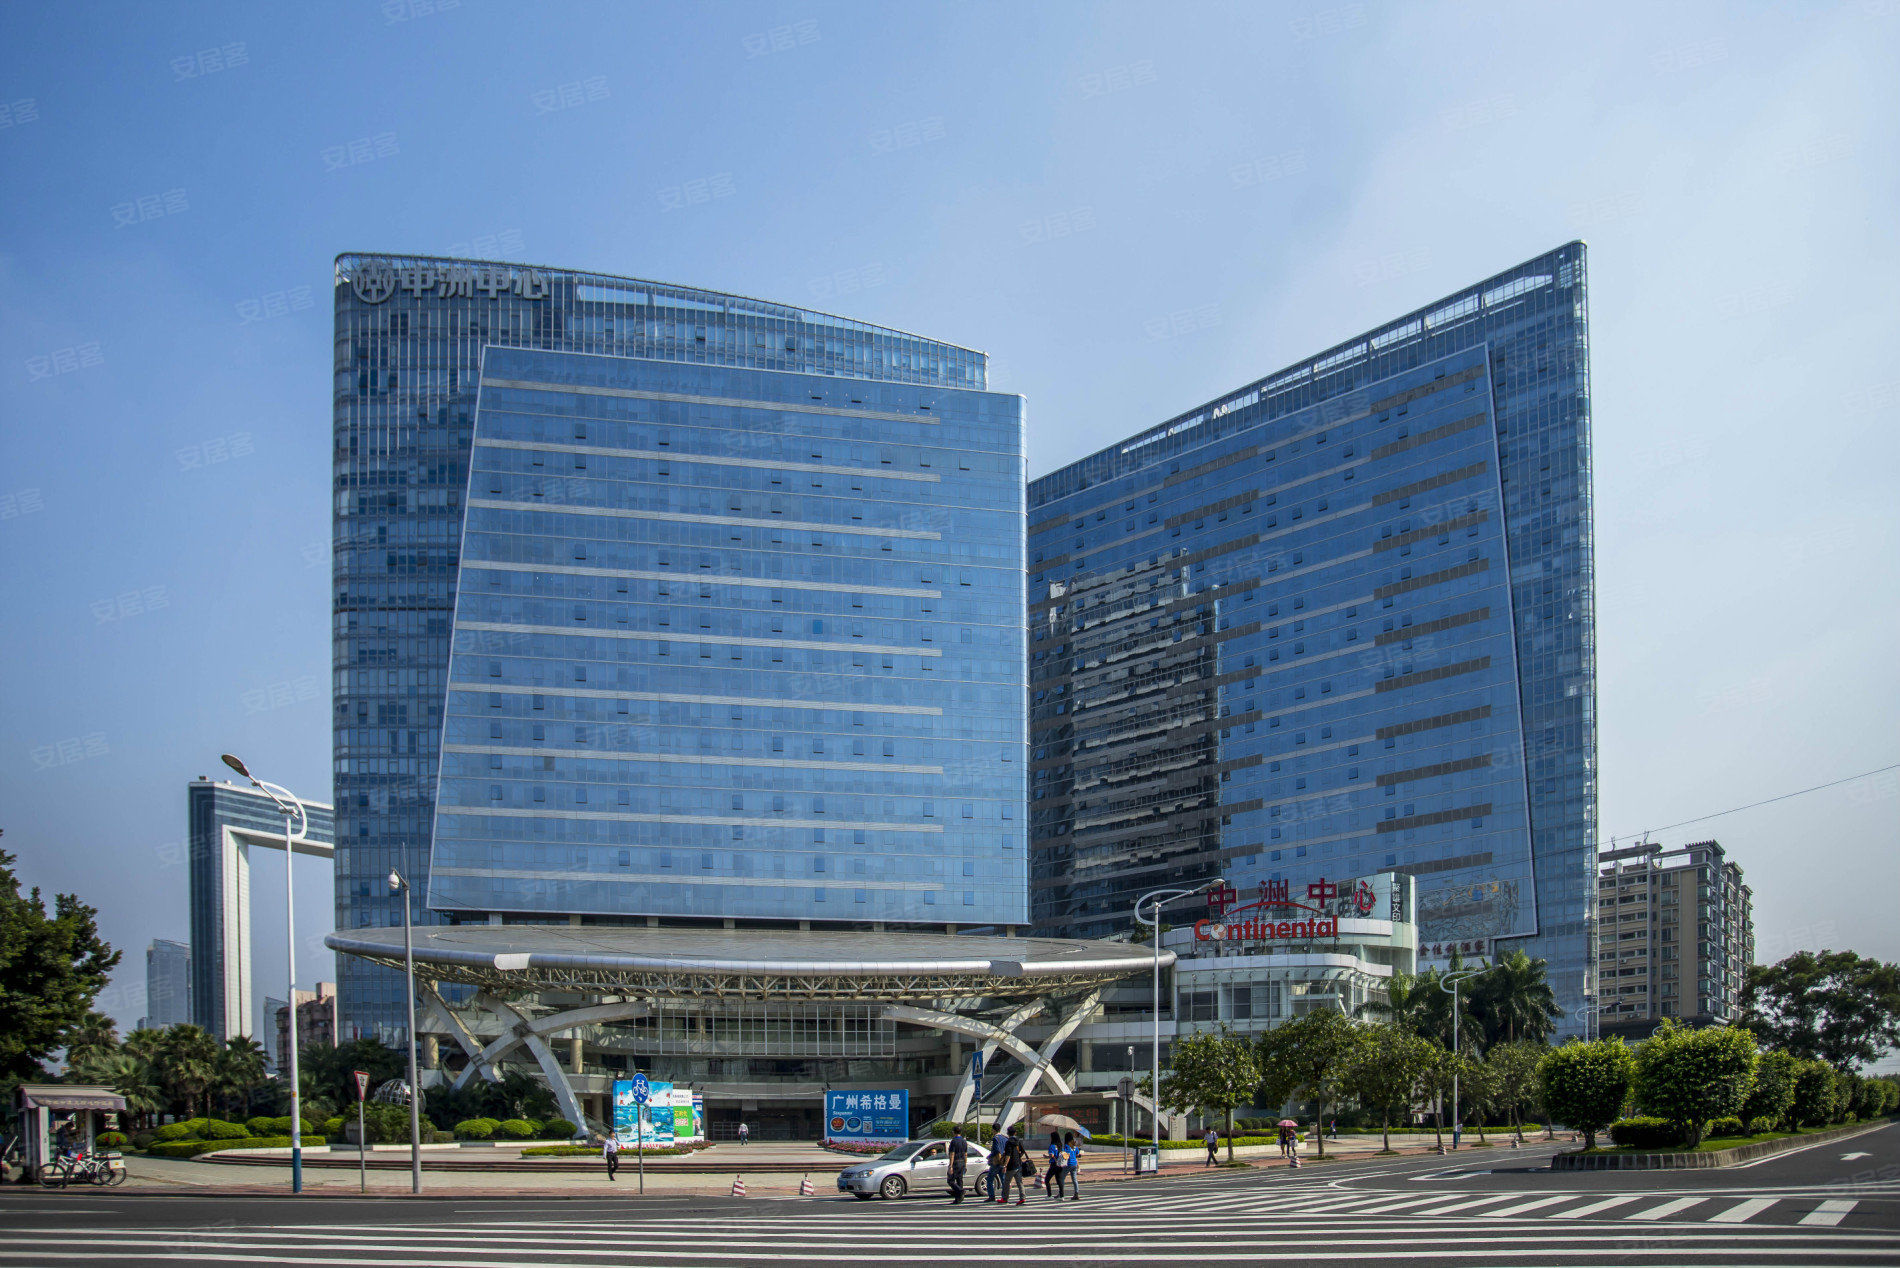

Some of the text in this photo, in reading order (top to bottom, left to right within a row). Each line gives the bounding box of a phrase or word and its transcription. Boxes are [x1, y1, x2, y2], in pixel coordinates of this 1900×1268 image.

[401, 265, 549, 299] 中洲中心
[1208, 878, 1377, 916] 中洲中心
[1194, 915, 1338, 942] Continental
[832, 1094, 902, 1110] 广州希格曼
